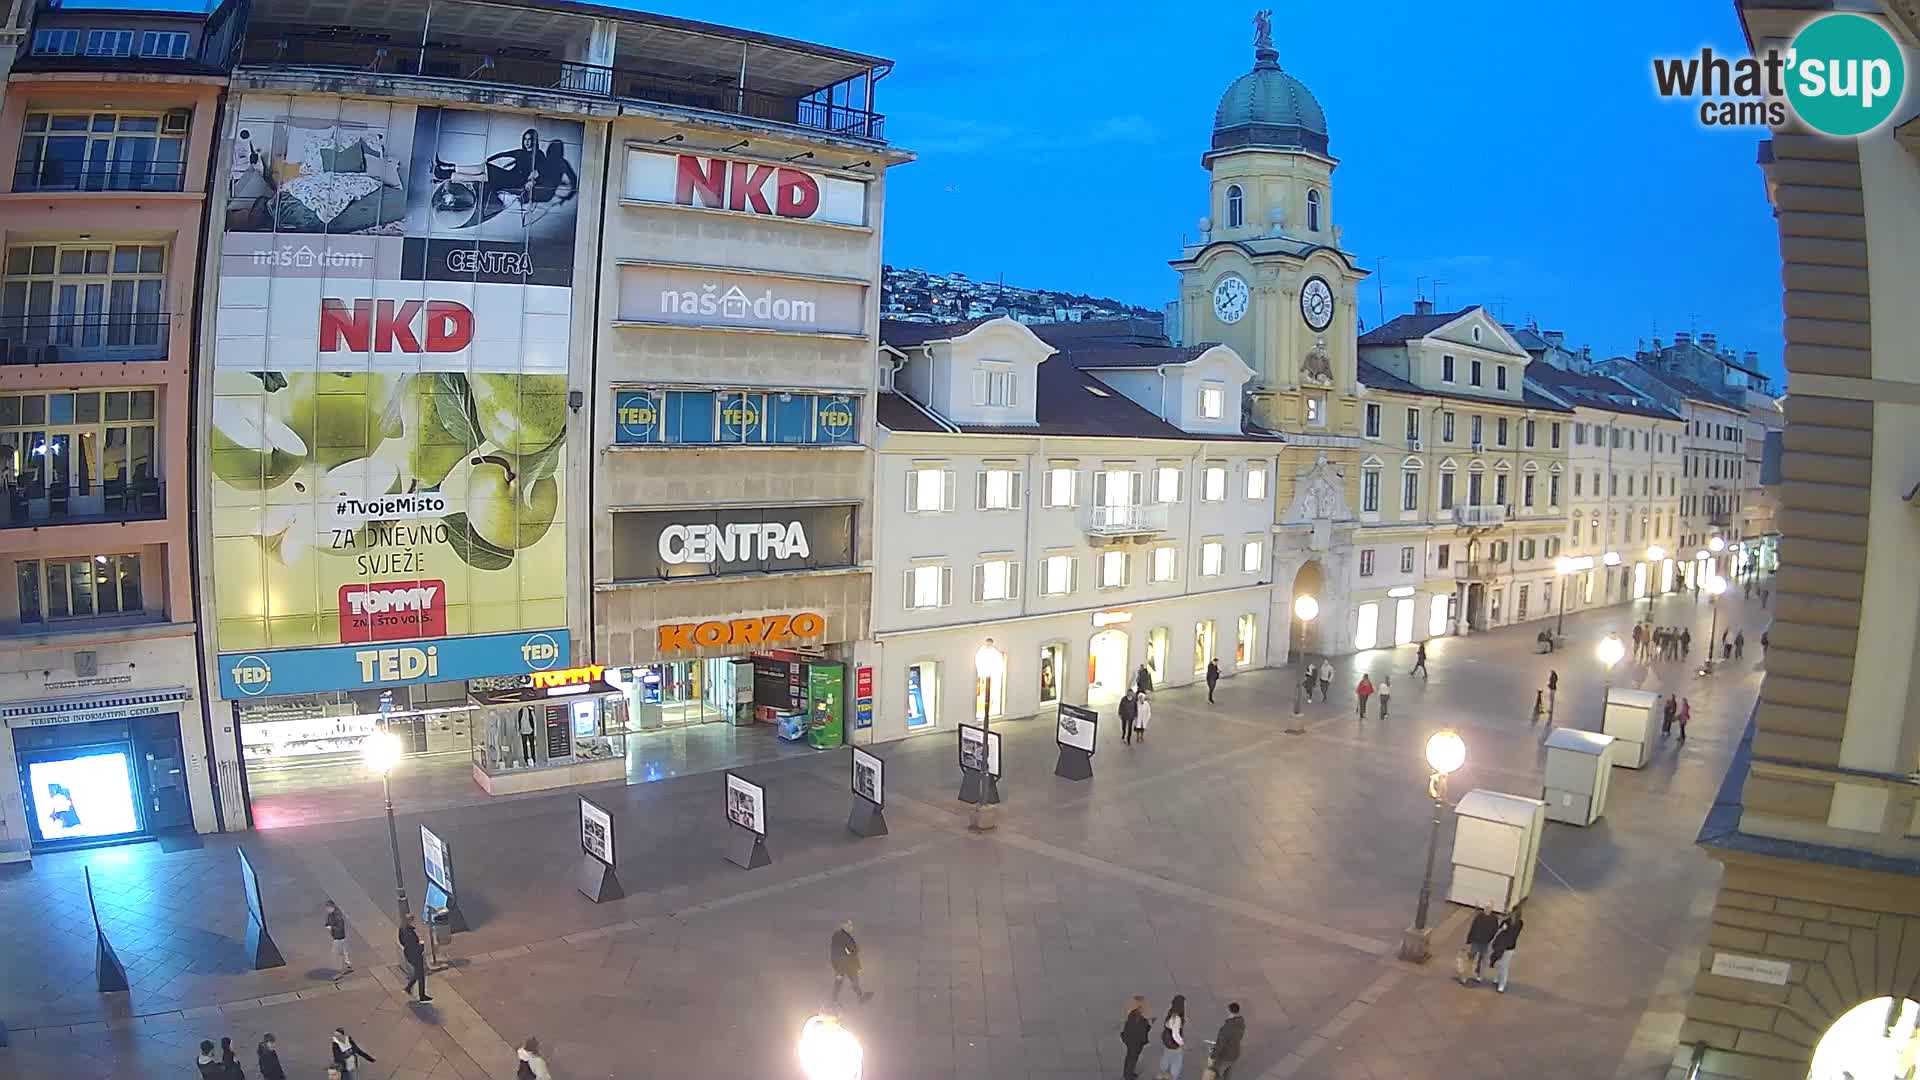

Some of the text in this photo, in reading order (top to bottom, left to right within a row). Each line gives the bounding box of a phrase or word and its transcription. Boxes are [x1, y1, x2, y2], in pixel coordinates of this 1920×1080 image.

[677, 154, 820, 219] NKD
[254, 245, 364, 268] naš dom
[447, 250, 534, 275] CENTRA
[661, 283, 816, 322] naš dom
[320, 297, 475, 353] NKD
[618, 408, 657, 425] TEDi
[723, 409, 759, 426] TEDi
[819, 411, 853, 426] TEDi
[336, 497, 445, 517] #TvojeMisto
[332, 524, 449, 549] ZA DNEVNO
[658, 521, 810, 564] CENTRA
[358, 548, 424, 575] SVJEŽE
[347, 586, 438, 614] TOMMY
[377, 614, 398, 625] ŠTO
[658, 613, 825, 651] KORZO
[356, 646, 438, 682] TEDi
[521, 643, 558, 660] TEDi
[232, 666, 271, 684] TEDi
[530, 664, 606, 689] TOMMY
[130, 706, 160, 717] CENTAR
